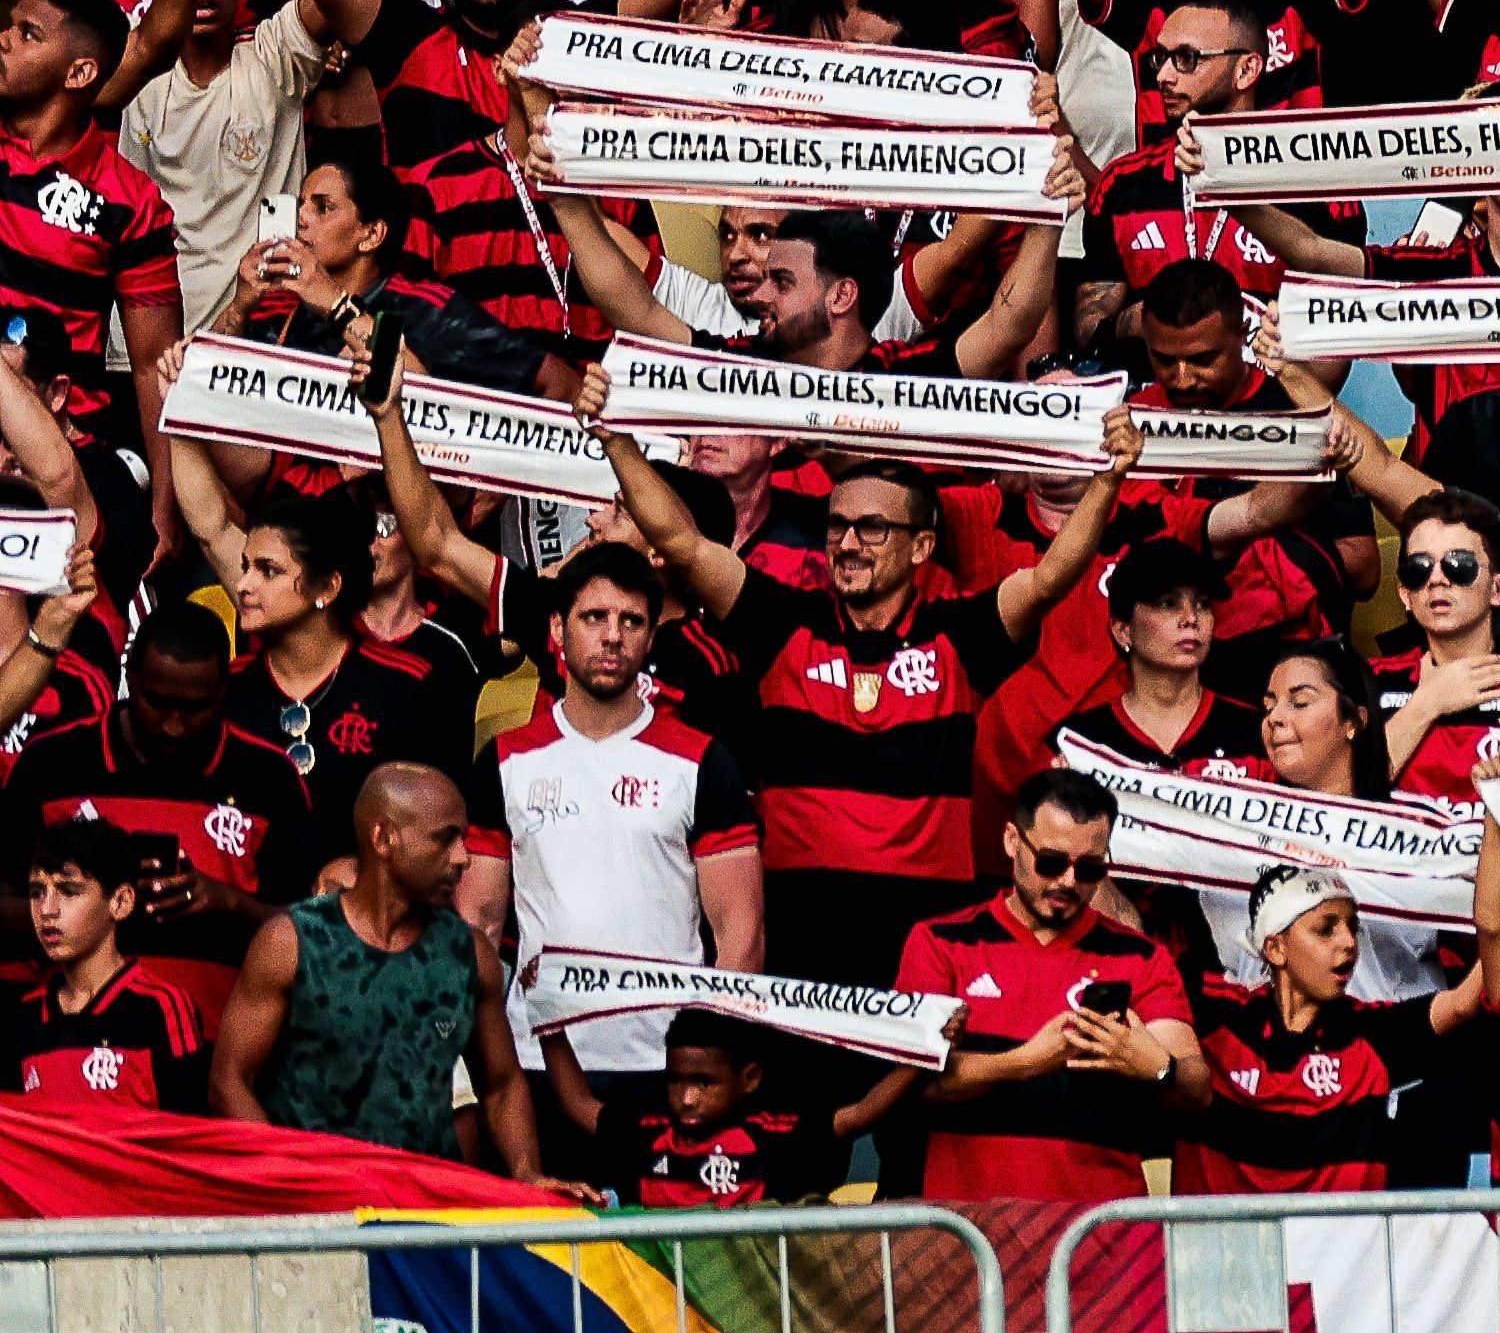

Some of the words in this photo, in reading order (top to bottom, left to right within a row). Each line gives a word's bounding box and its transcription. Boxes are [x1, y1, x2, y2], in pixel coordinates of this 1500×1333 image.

[567, 31, 622, 60] PRA
[633, 41, 710, 69] CIMA
[720, 51, 809, 83] DELES,
[1431, 166, 1494, 177] Betano
[629, 362, 688, 390] PRA
[697, 367, 781, 397] CIMA
[790, 372, 884, 409] DELES,
[895, 381, 1080, 420] FLAMENGO!
